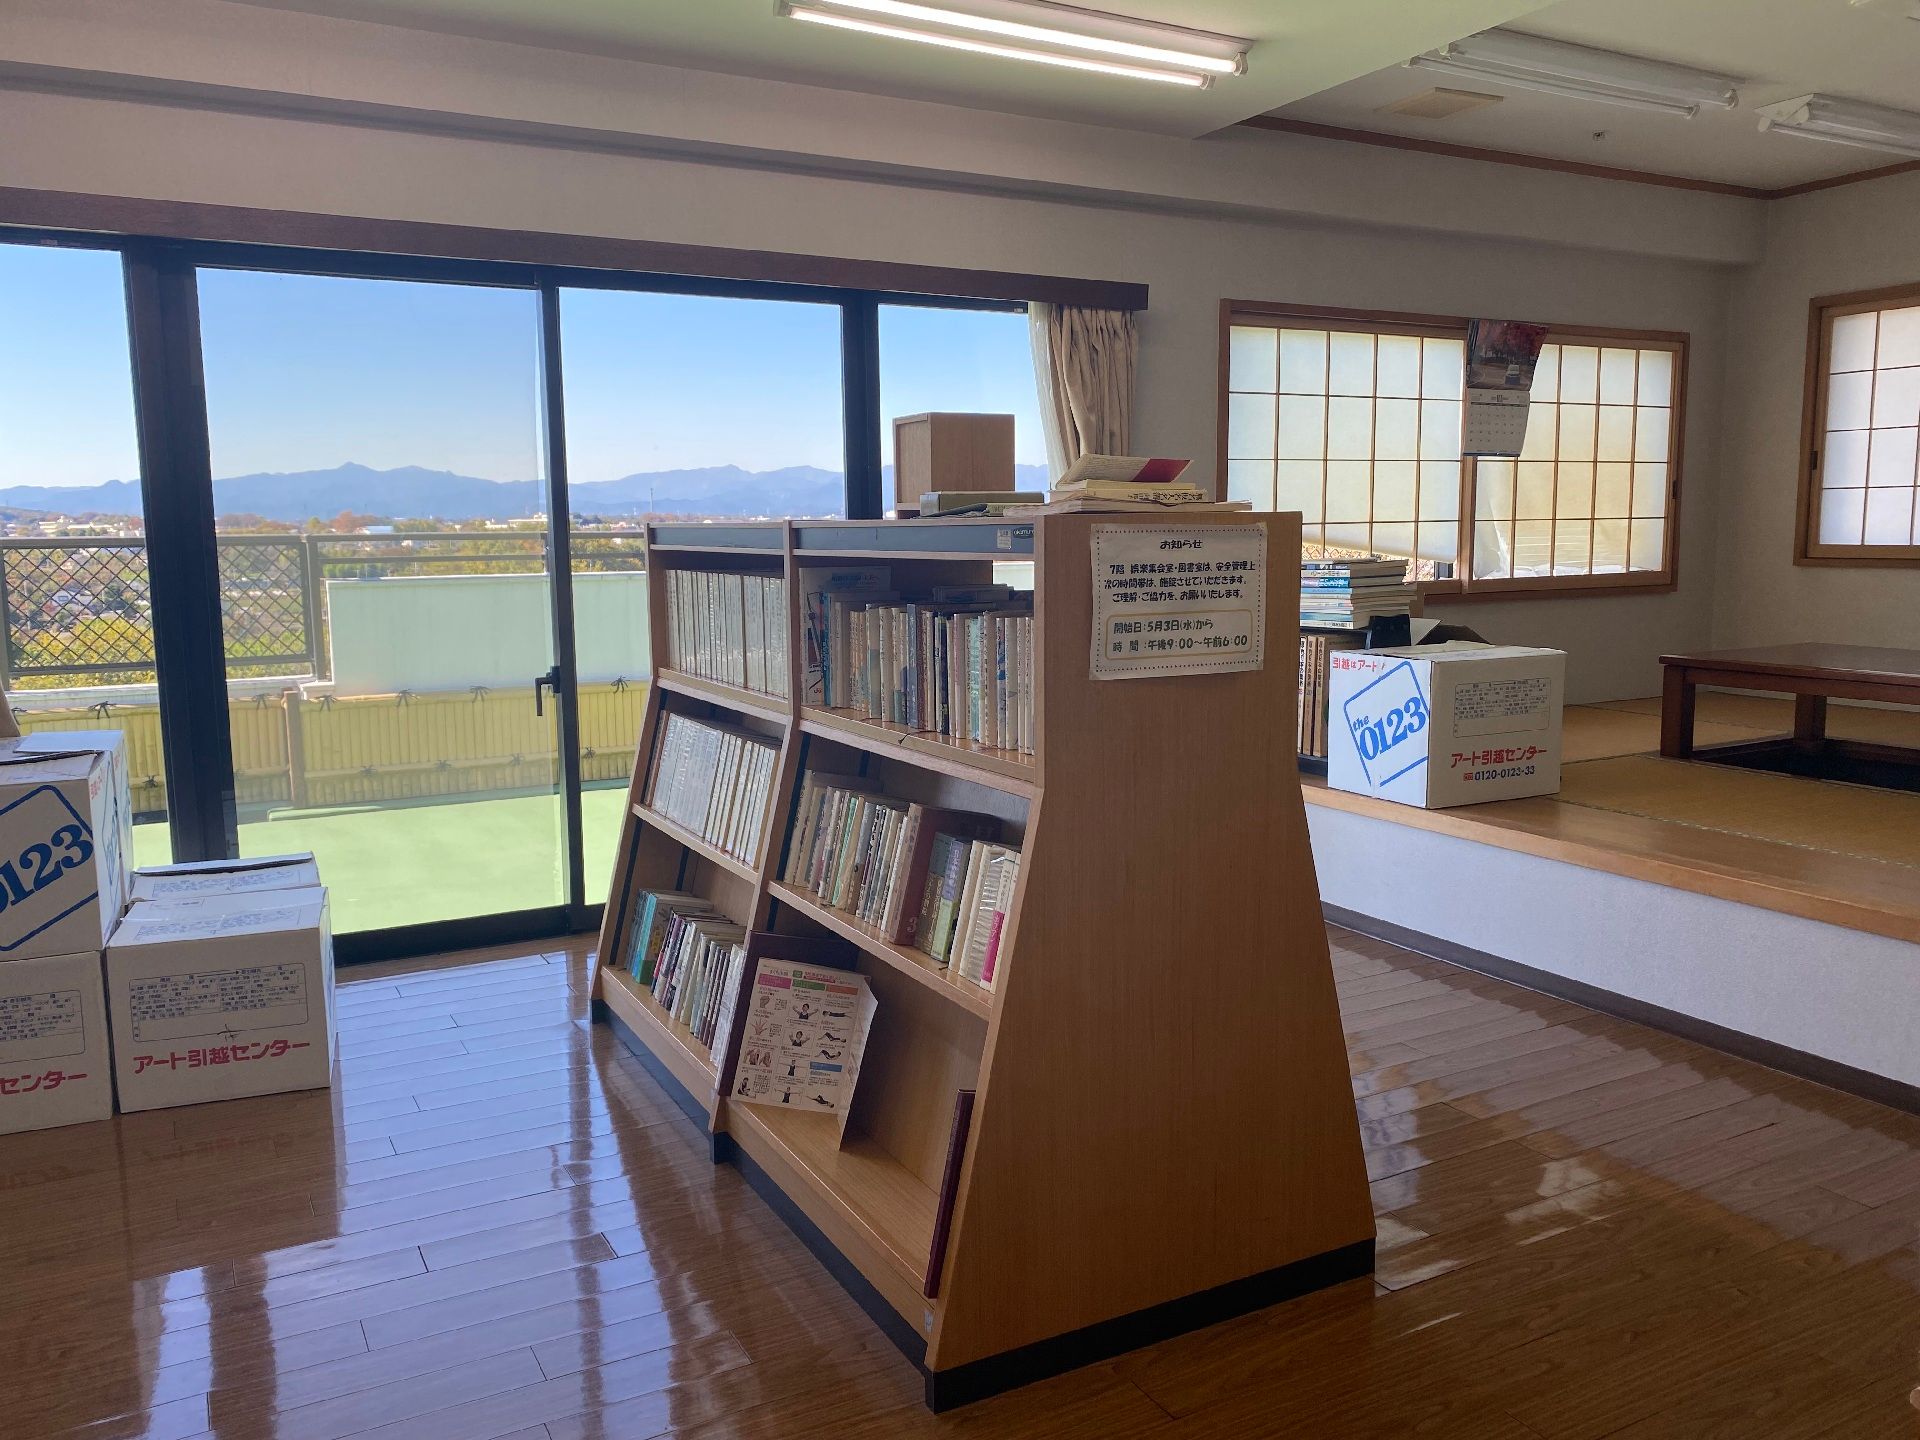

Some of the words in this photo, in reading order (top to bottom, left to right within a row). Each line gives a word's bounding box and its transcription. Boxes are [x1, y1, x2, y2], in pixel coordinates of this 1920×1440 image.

[1159, 539, 1203, 550] お知らせ
[1109, 563, 1125, 575] 7階
[1353, 715, 1370, 732] the
[1359, 696, 1427, 761] 0123
[1450, 745, 1548, 769] アート引越センター
[0, 823, 94, 914] 123
[132, 1039, 311, 1074] アート引越センター
[0, 1070, 88, 1095] センター
